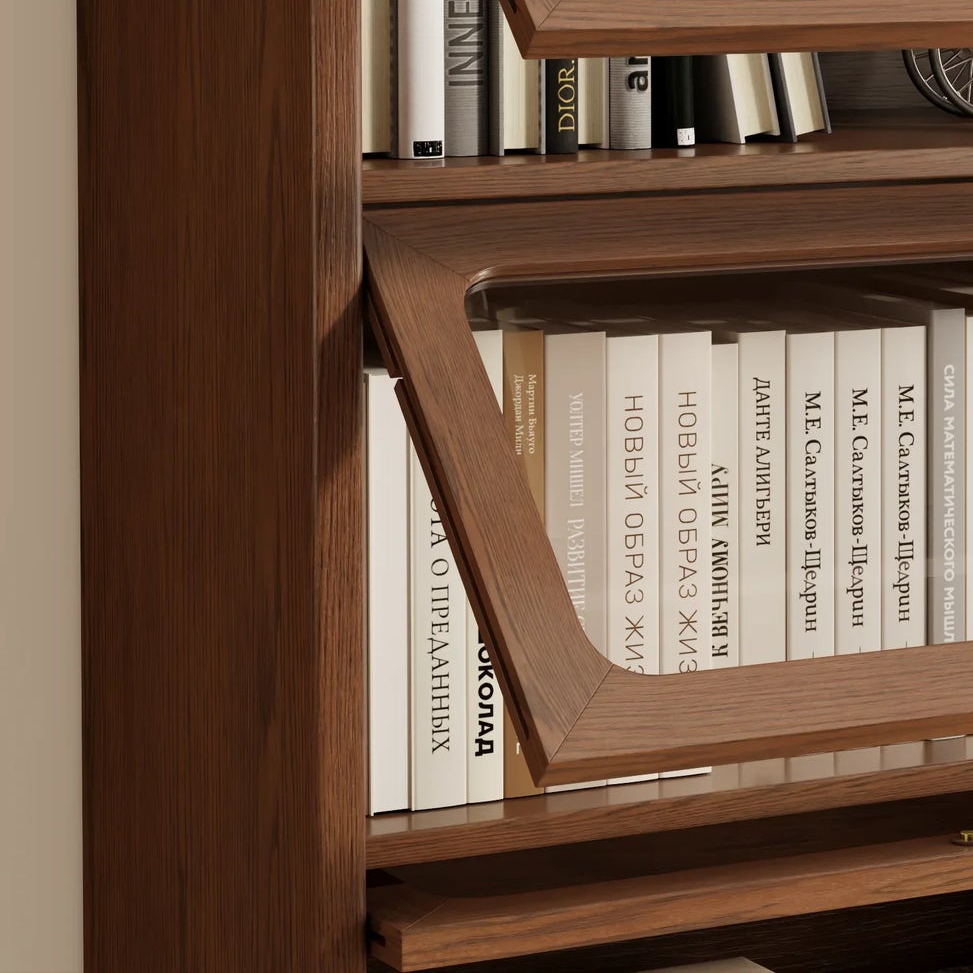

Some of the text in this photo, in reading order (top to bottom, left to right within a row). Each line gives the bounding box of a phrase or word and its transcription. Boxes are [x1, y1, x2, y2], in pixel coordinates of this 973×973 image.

[557, 59, 576, 133] DIOR.
[512, 374, 524, 422] Джордан
[525, 374, 537, 455] Мартин Бьяуго
[568, 393, 584, 447] УОЛТЕР
[944, 364, 955, 412] СИЛА
[569, 449, 585, 508] МИШЕЛ
[624, 395, 648, 500] НОВЫЙ
[678, 391, 701, 496] НОВЫЙ
[753, 377, 771, 546] ДАНТЕ АЛИГЬЕРИ
[711, 463, 729, 527] МИРУ
[799, 391, 822, 633] М.Е. Салтыков-Щедрин
[846, 388, 868, 628] М.Е. Салтыков-Щедрин
[893, 384, 915, 623] М.Е. Салтыков-Щедрин
[944, 416, 955, 582] МАТЕМАТИЧЕСКОГО
[624, 513, 644, 604] ОБРАЗ
[678, 508, 698, 599] ОБРАЗ
[711, 537, 729, 638] ВЕЧНОМУ
[427, 584, 450, 754] ПРЕДАННЫХ
[475, 627, 495, 757] ОКОЛАД
